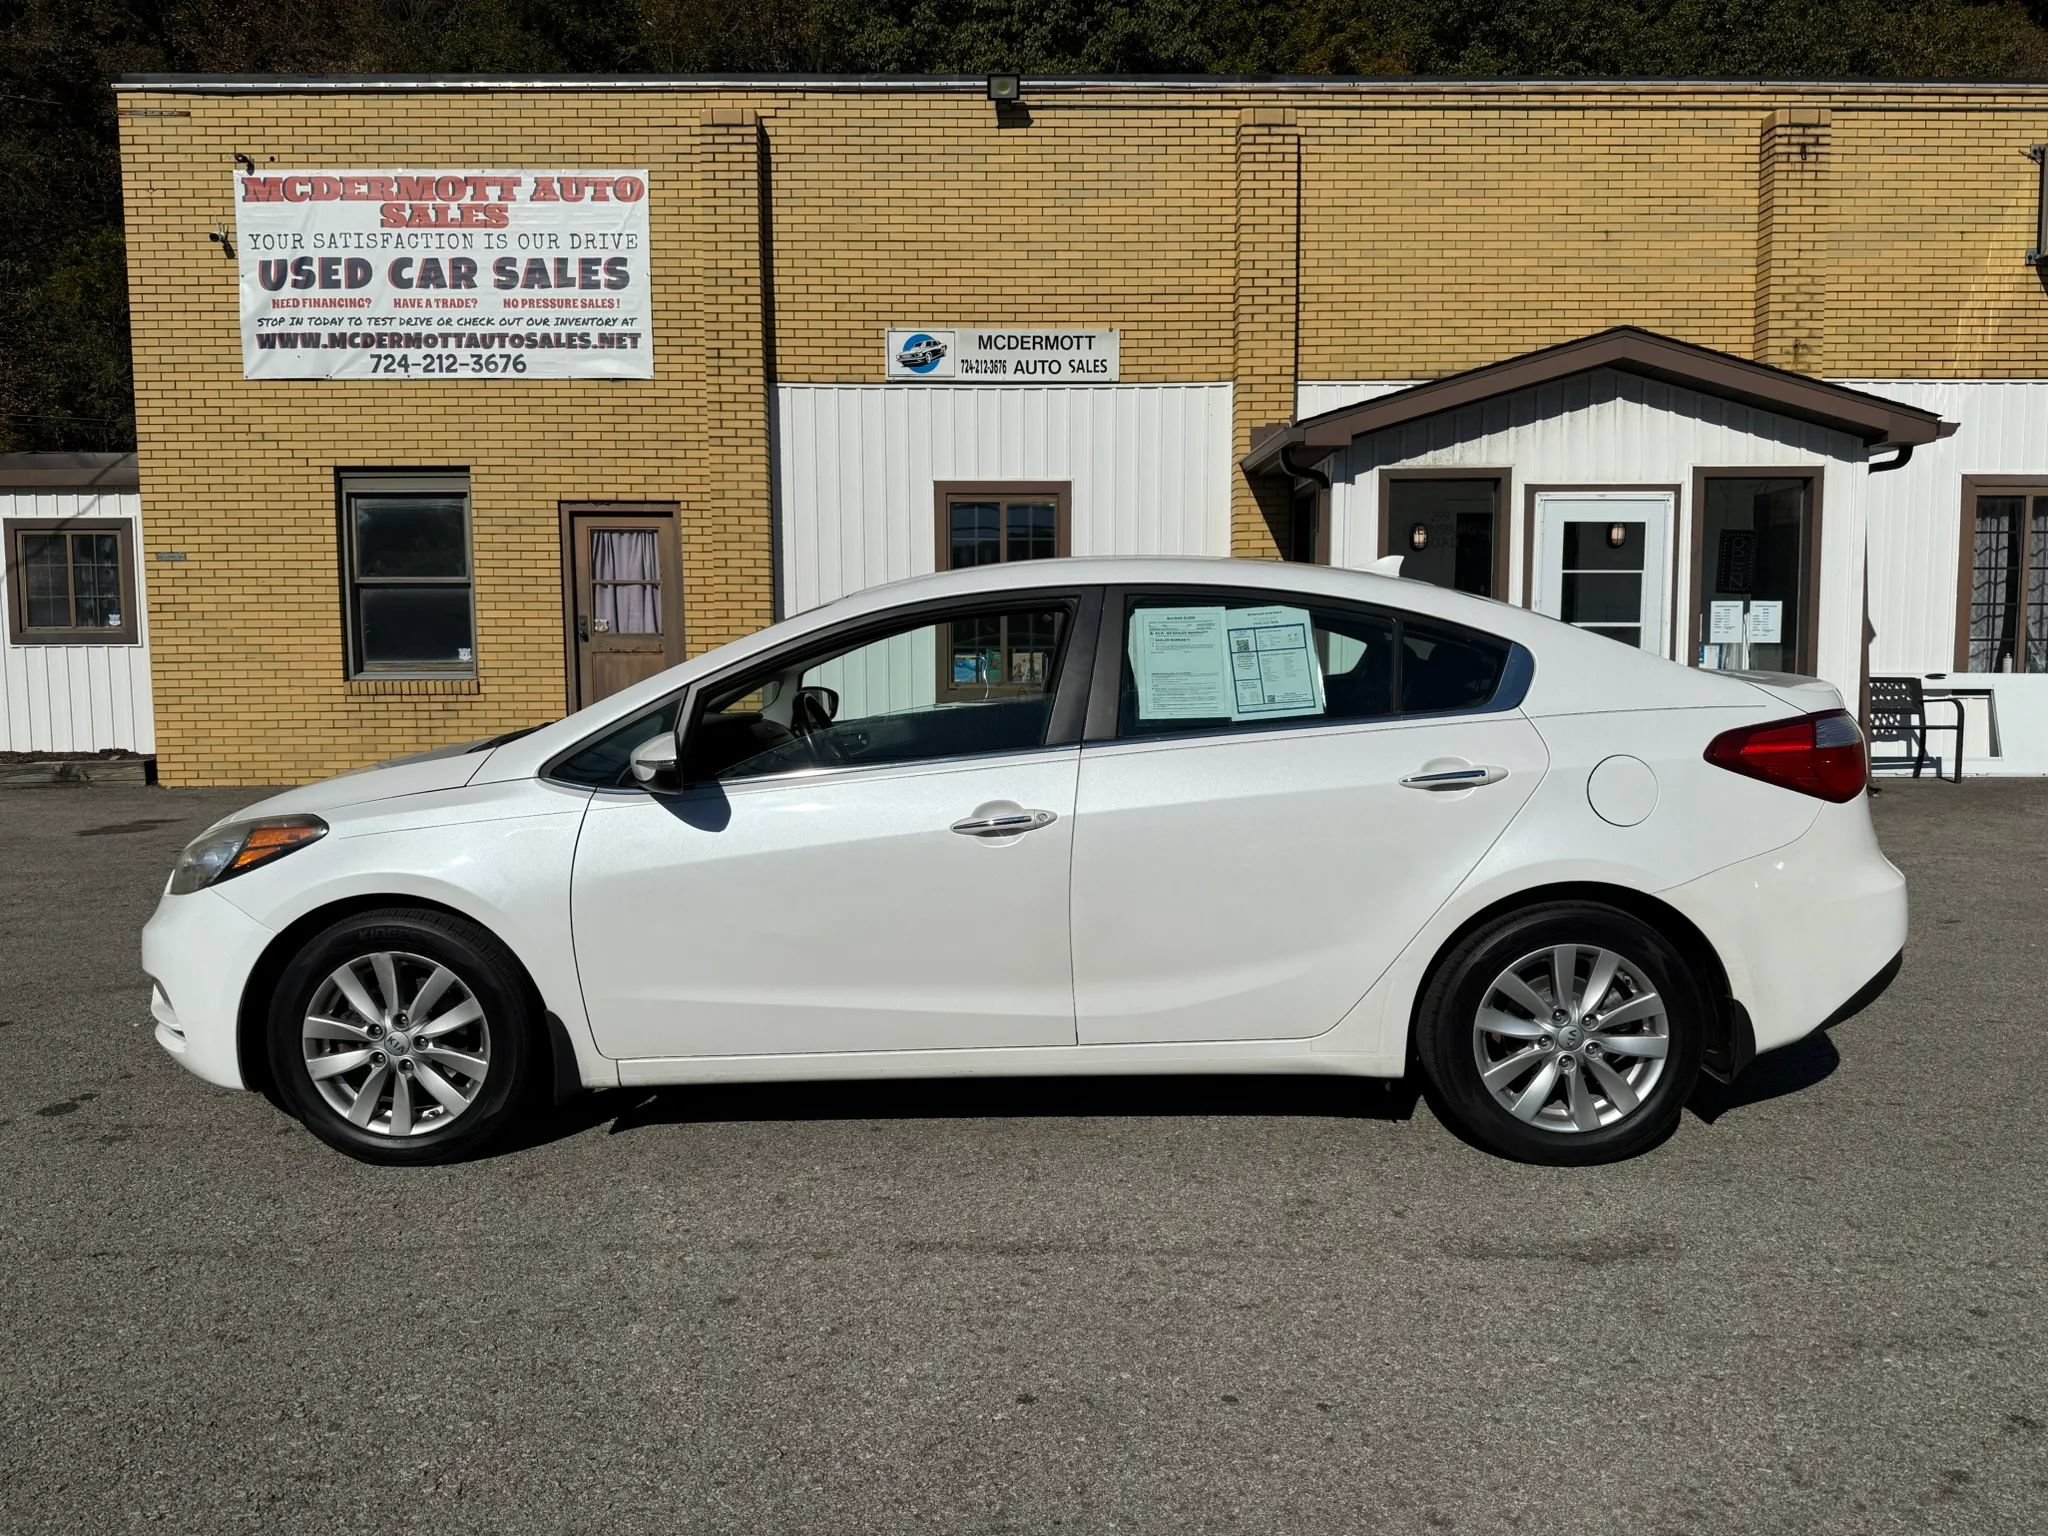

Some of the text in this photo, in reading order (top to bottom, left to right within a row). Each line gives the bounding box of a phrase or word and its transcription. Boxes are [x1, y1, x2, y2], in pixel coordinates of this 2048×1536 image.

[241, 176, 645, 203] MCDERMOTT AUTO
[380, 203, 509, 228] SALES
[248, 233, 638, 250] YOUR SATISFACTION IS OUR DRIVE
[258, 256, 630, 291] USED CAR SALES
[272, 297, 372, 309] NEED FINANCING?
[394, 297, 478, 309] HAVE A TRADE?
[503, 298, 520, 309] NO
[521, 298, 579, 309] PRESSURE
[257, 317, 638, 327] STOP IN TODAY TO TEST DRIVE OR CHECK OUT OUR INVENTORY AT
[978, 335, 1096, 351] MCDERMOTT
[370, 353, 527, 374] 724-212-3676
[960, 358, 1007, 375] 724-212-3676
[1013, 358, 1108, 375] AUTO SALES
[386, 1036, 405, 1055] KIA
